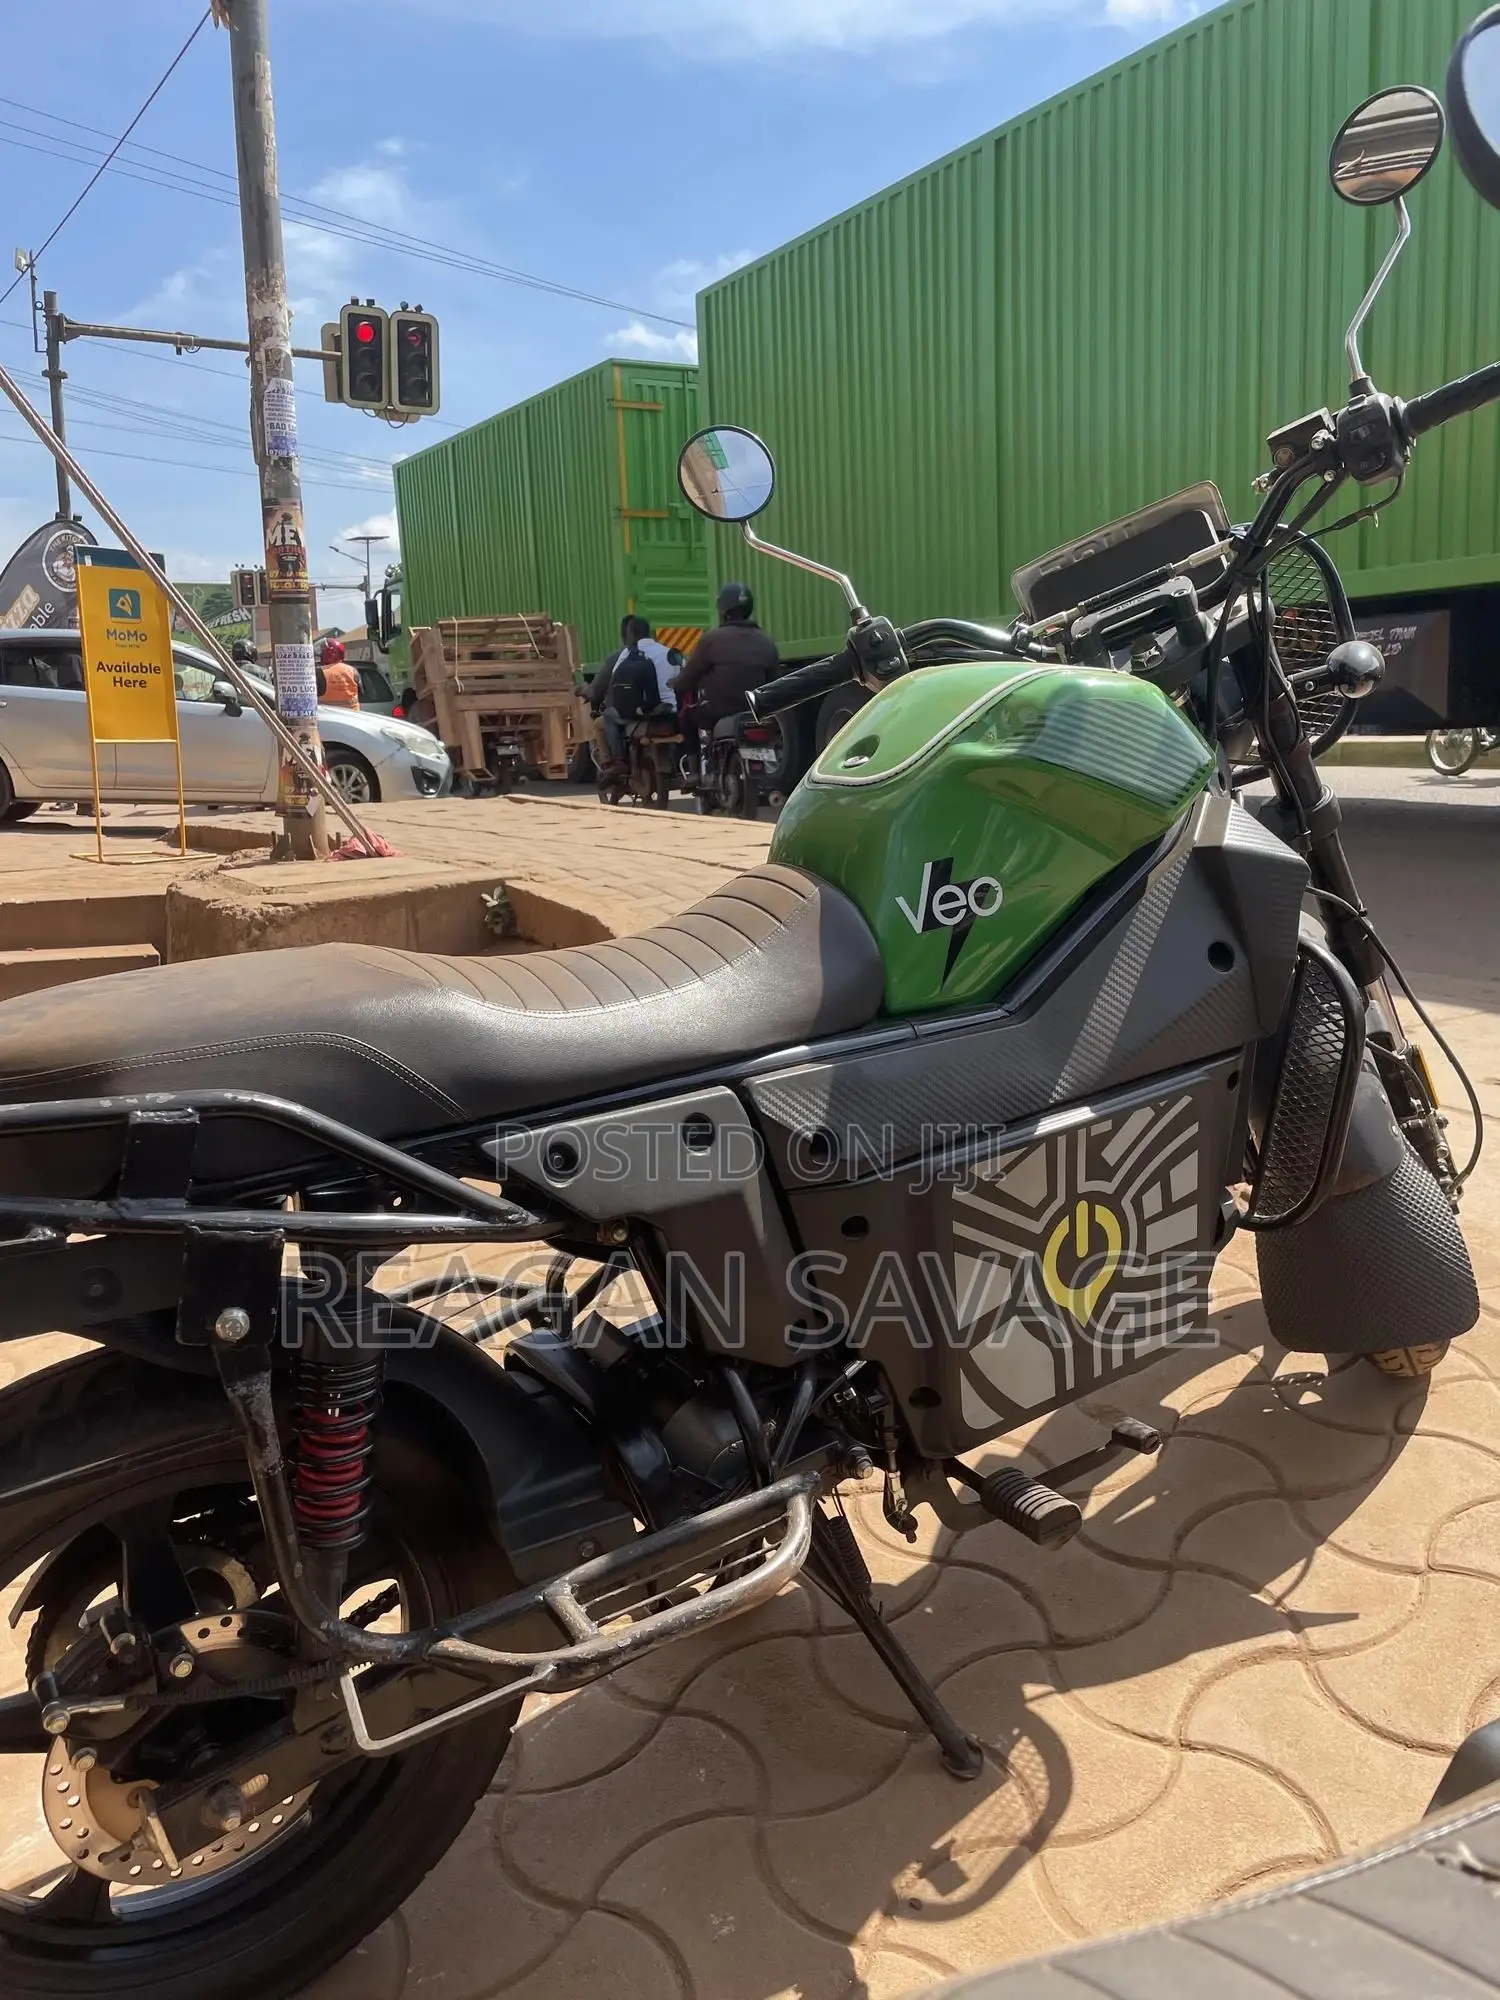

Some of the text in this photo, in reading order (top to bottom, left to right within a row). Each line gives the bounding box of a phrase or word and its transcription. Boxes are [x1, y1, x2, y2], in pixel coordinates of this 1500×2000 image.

[269, 422, 287, 430] BAD
[49, 537, 62, 552] THE
[106, 628, 148, 642] MoMo
[96, 661, 161, 675] Available
[112, 676, 148, 689] Here
[281, 685, 298, 693] BAD
[894, 861, 1003, 935] Veo
